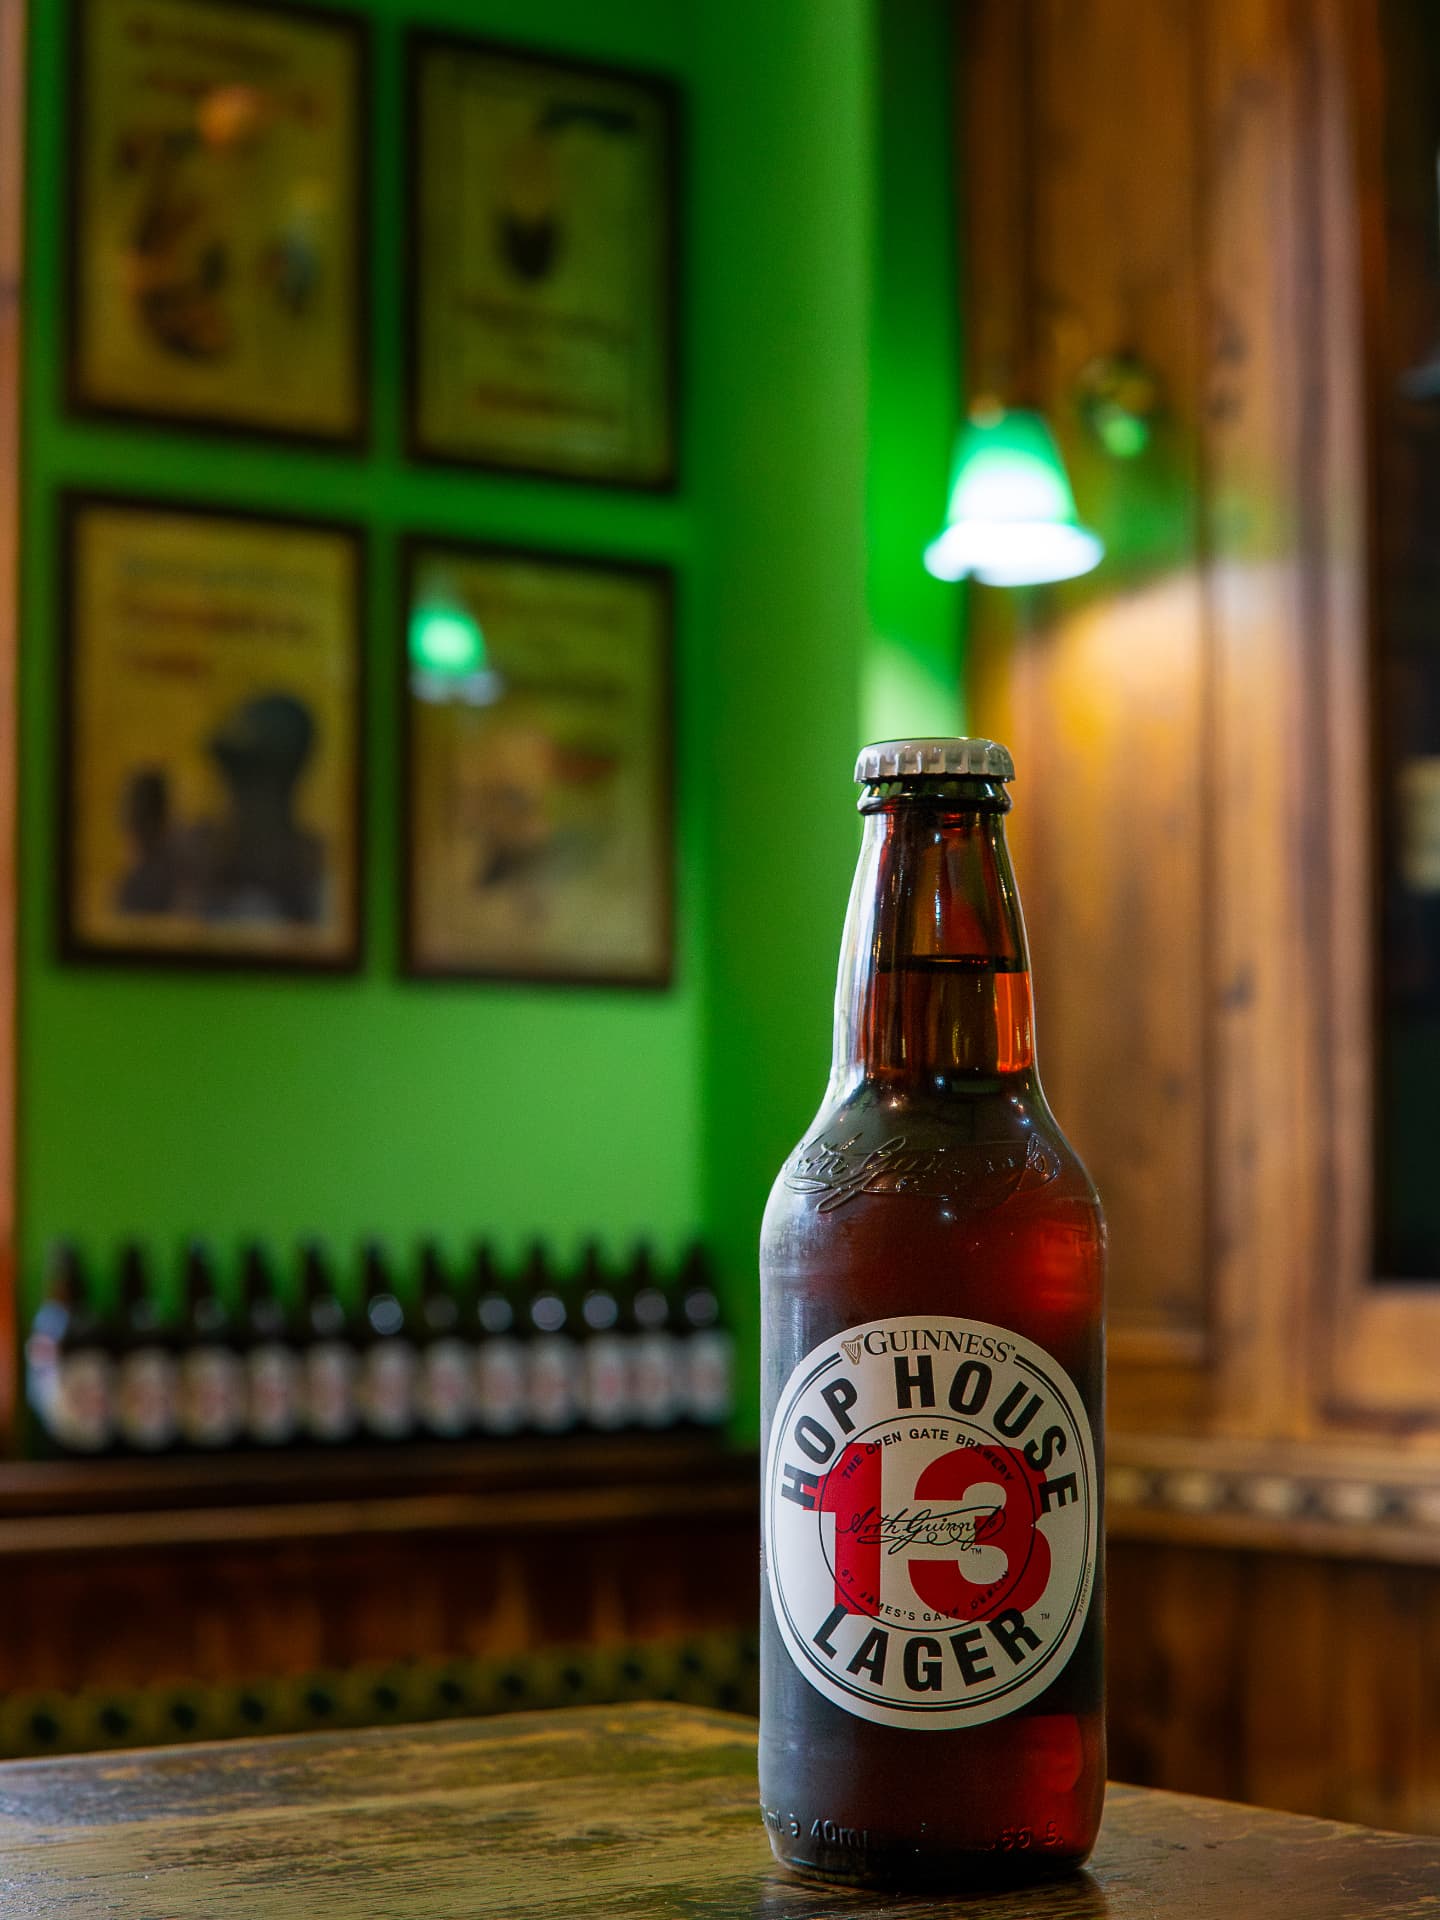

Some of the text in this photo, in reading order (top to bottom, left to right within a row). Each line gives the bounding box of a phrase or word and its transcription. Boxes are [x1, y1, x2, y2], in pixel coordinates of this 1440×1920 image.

[863, 1329, 1011, 1363] GUINNESS
[781, 1354, 1079, 1515] HOP HOUSE
[842, 1428, 1015, 1482] THE OPEN GATE BREWERY
[803, 1442, 1052, 1622] 13
[812, 1603, 1043, 1692] LAGER
